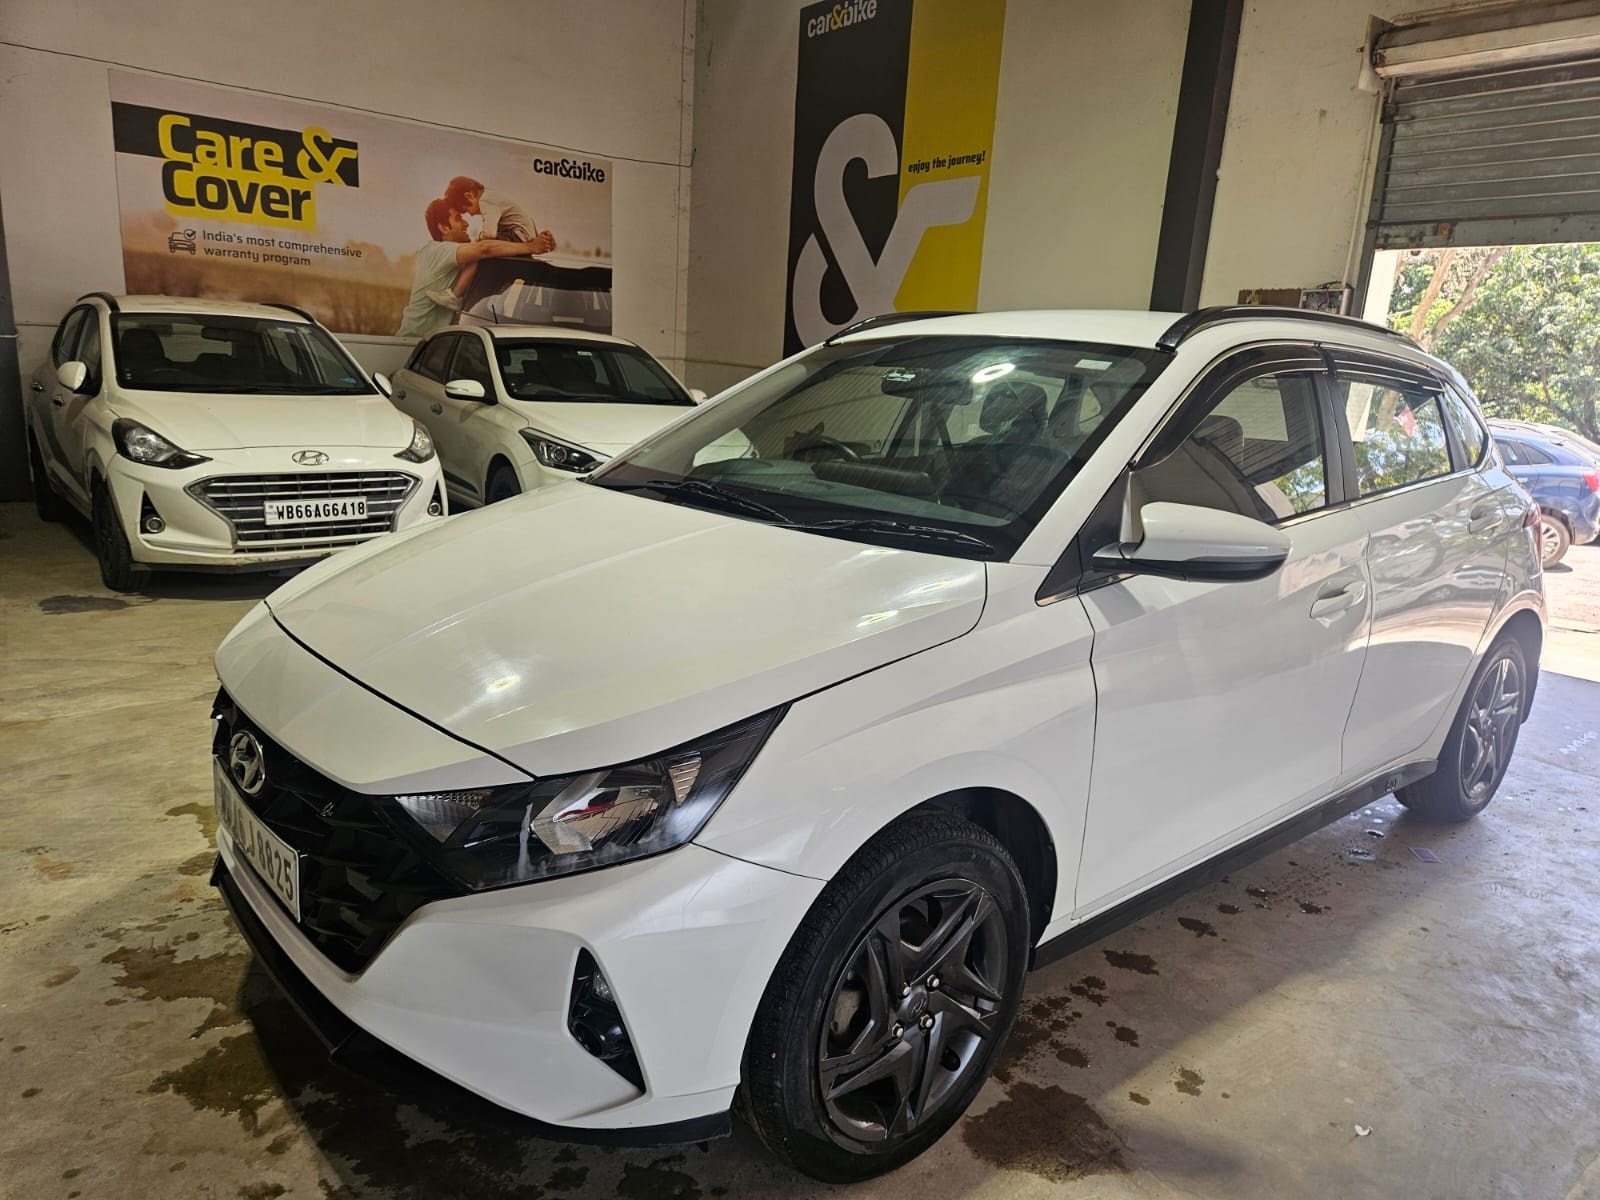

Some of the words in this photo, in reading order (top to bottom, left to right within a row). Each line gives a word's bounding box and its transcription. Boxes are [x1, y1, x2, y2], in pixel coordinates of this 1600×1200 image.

[807, 0, 878, 38] car&bike
[158, 114, 284, 173] Care
[297, 125, 358, 185] &
[908, 160, 930, 174] enjoy
[932, 156, 946, 169] the
[947, 150, 986, 169] journey!
[533, 158, 605, 183] car&bike
[161, 160, 311, 221] Cover
[202, 230, 243, 244] India's
[246, 235, 275, 247] most
[278, 240, 362, 258] comprehensive
[203, 247, 260, 263] warranty
[262, 254, 311, 266] program
[276, 501, 365, 521] WB66AG6418
